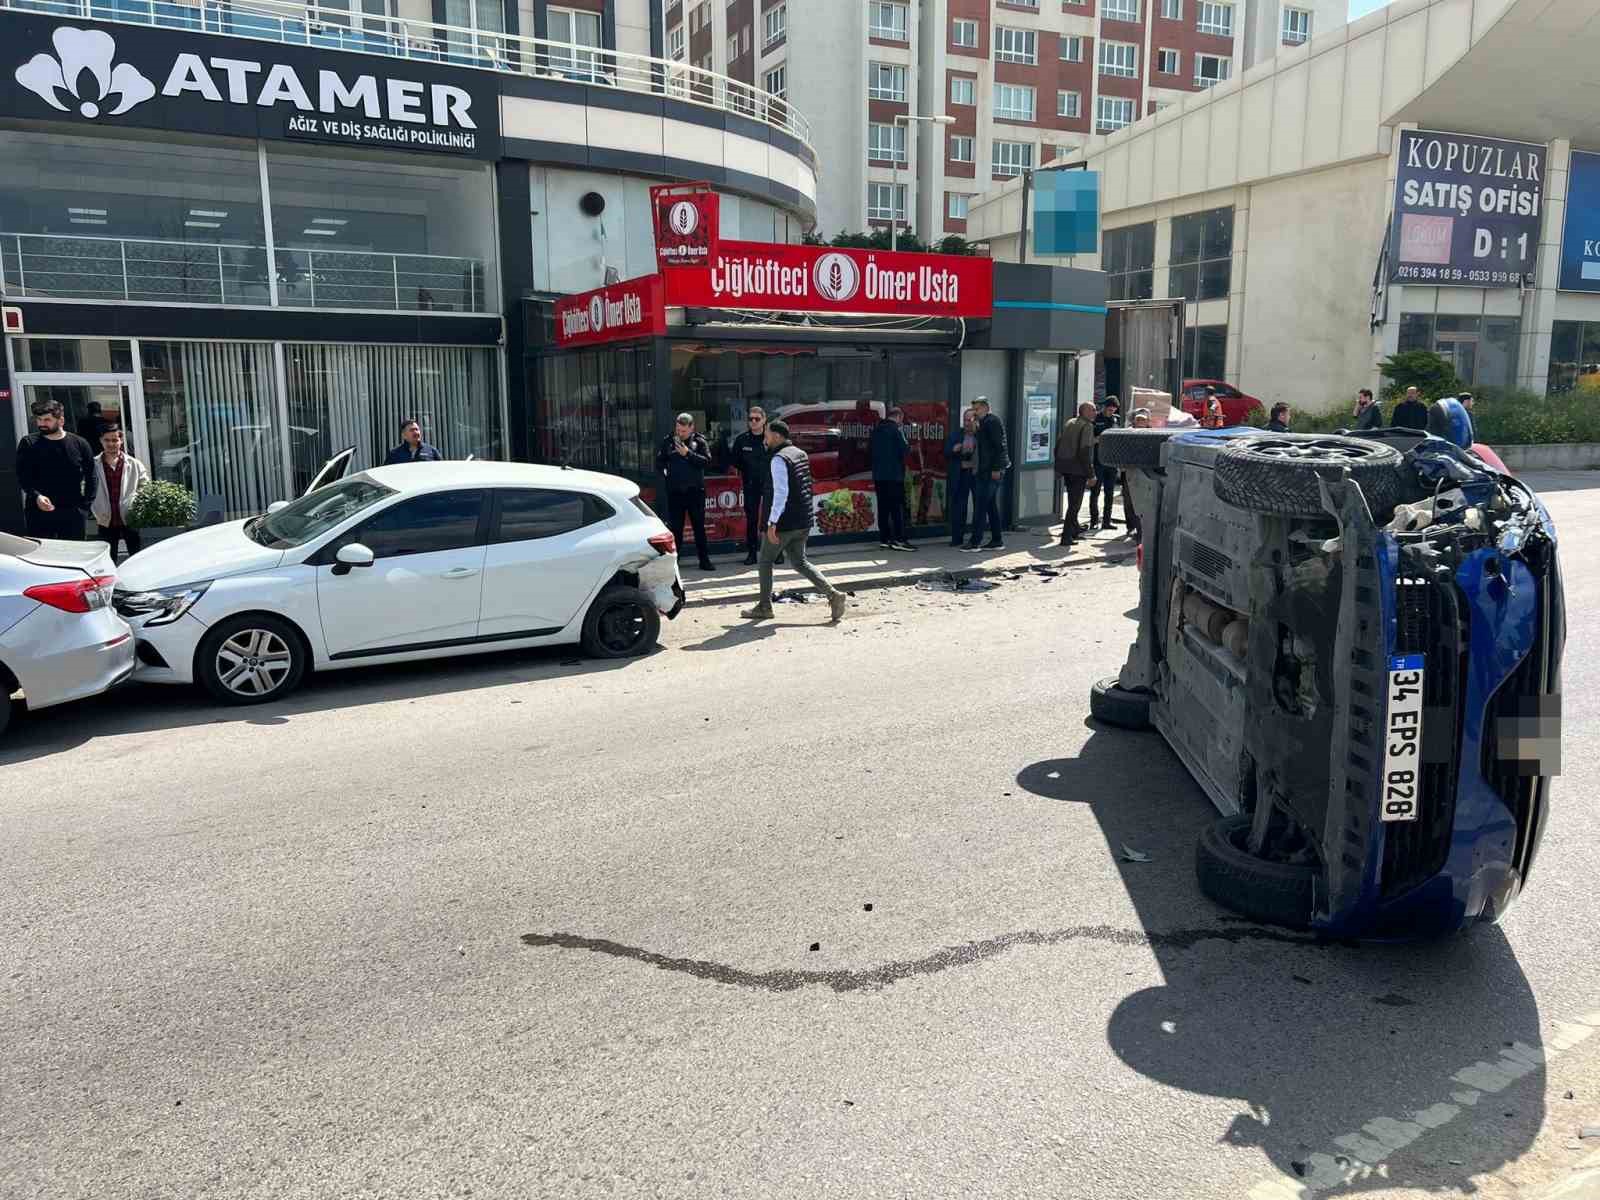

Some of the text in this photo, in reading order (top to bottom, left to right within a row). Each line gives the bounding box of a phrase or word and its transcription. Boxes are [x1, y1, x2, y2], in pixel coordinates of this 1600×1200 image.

[162, 53, 477, 129] ATAMER
[288, 115, 475, 149] AĞIZ VE DİŞ SAĞLIĞI POLİKLİNİĞİ
[1406, 136, 1540, 182] KOPUZLAR
[1403, 179, 1539, 217] SATIŞ OFİSİ
[711, 255, 958, 304] Çiğköfteci Ömer Usta
[1398, 266, 1418, 278] 0216
[1420, 267, 1436, 279] 394
[1440, 268, 1450, 280] 18
[1469, 270, 1490, 281] 0533
[604, 291, 624, 328] Ömer
[624, 292, 642, 325] Usta
[1386, 671, 1420, 816] 34 EPS 828
